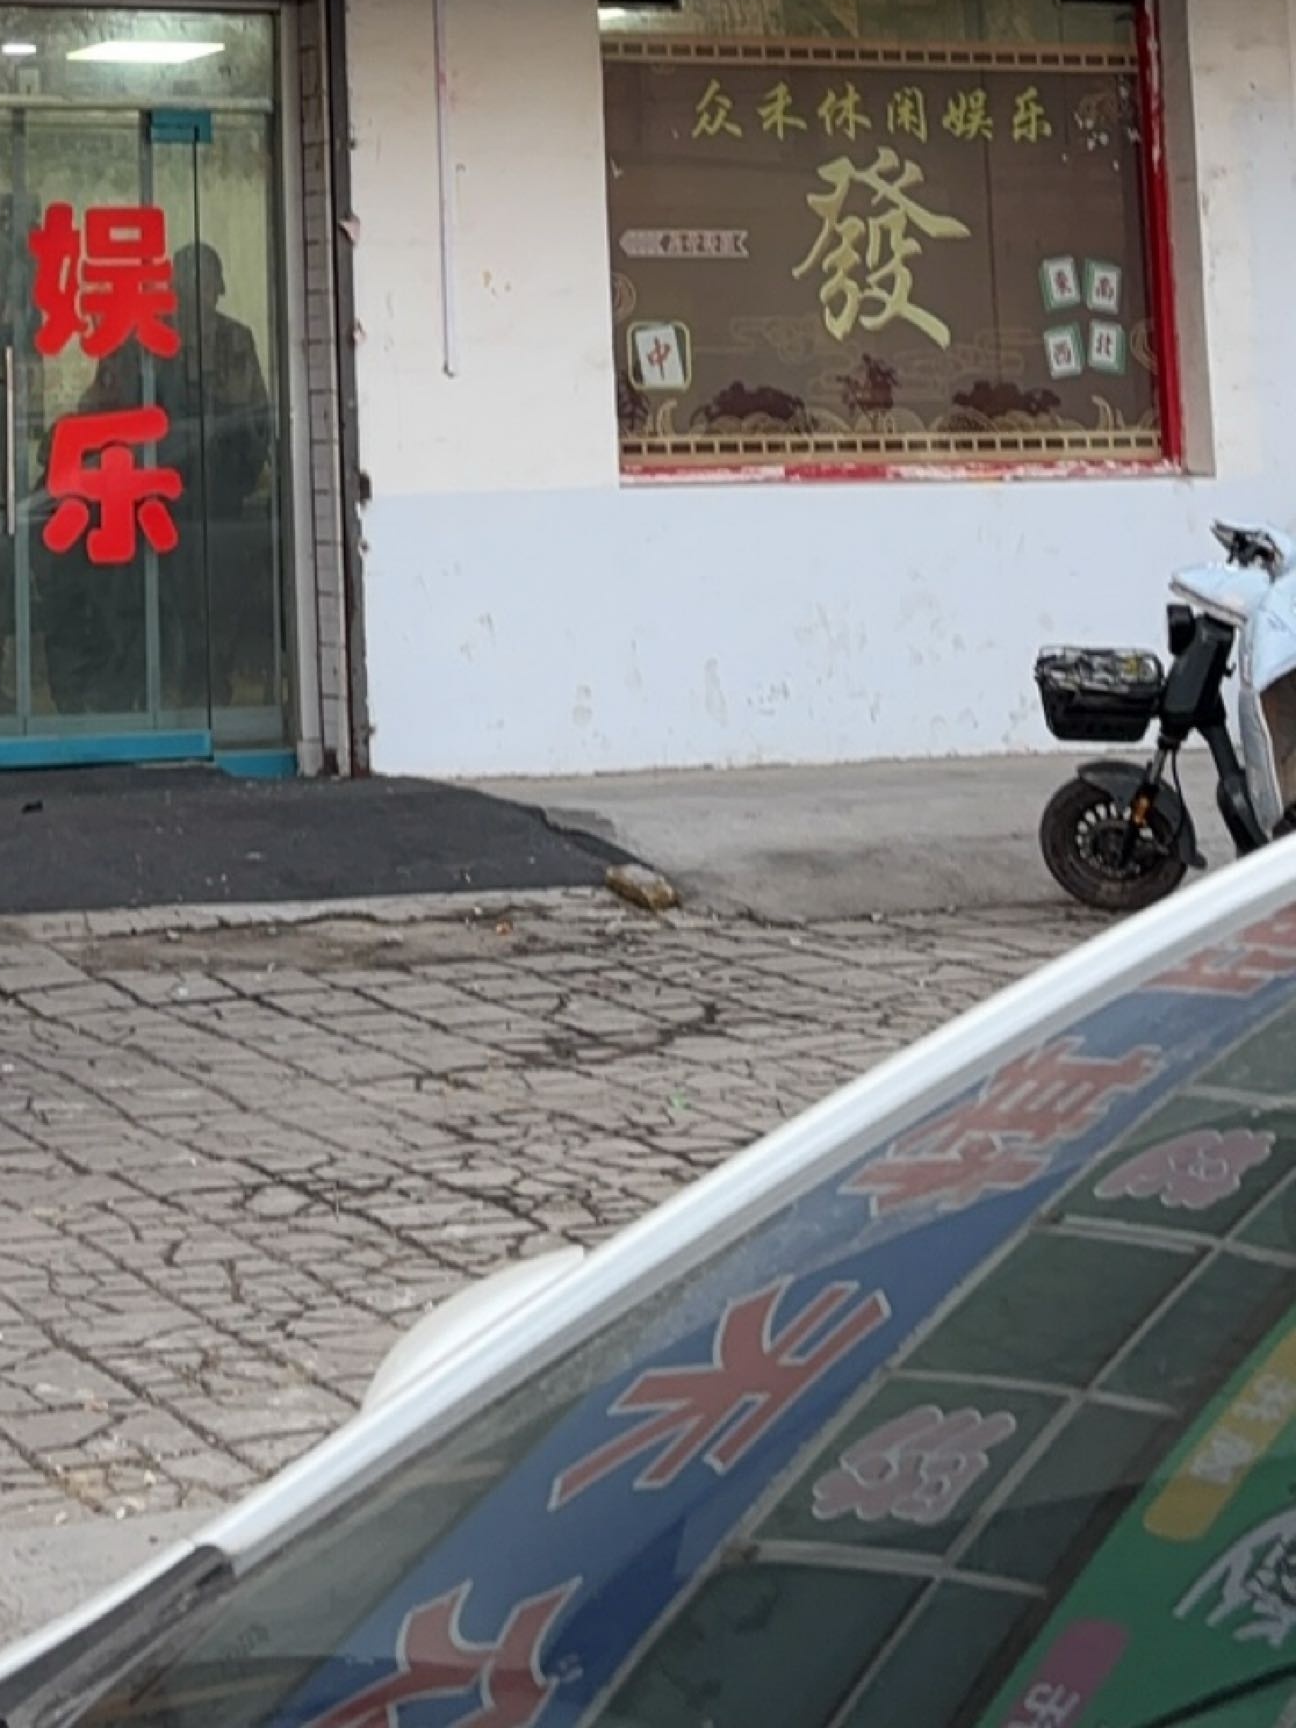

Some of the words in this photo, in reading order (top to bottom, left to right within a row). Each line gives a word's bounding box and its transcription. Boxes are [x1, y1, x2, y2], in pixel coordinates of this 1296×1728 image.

[690, 78, 1053, 144] 众禾休闲娱乐
[792, 146, 972, 350] 發
[28, 201, 184, 565] 娱乐
